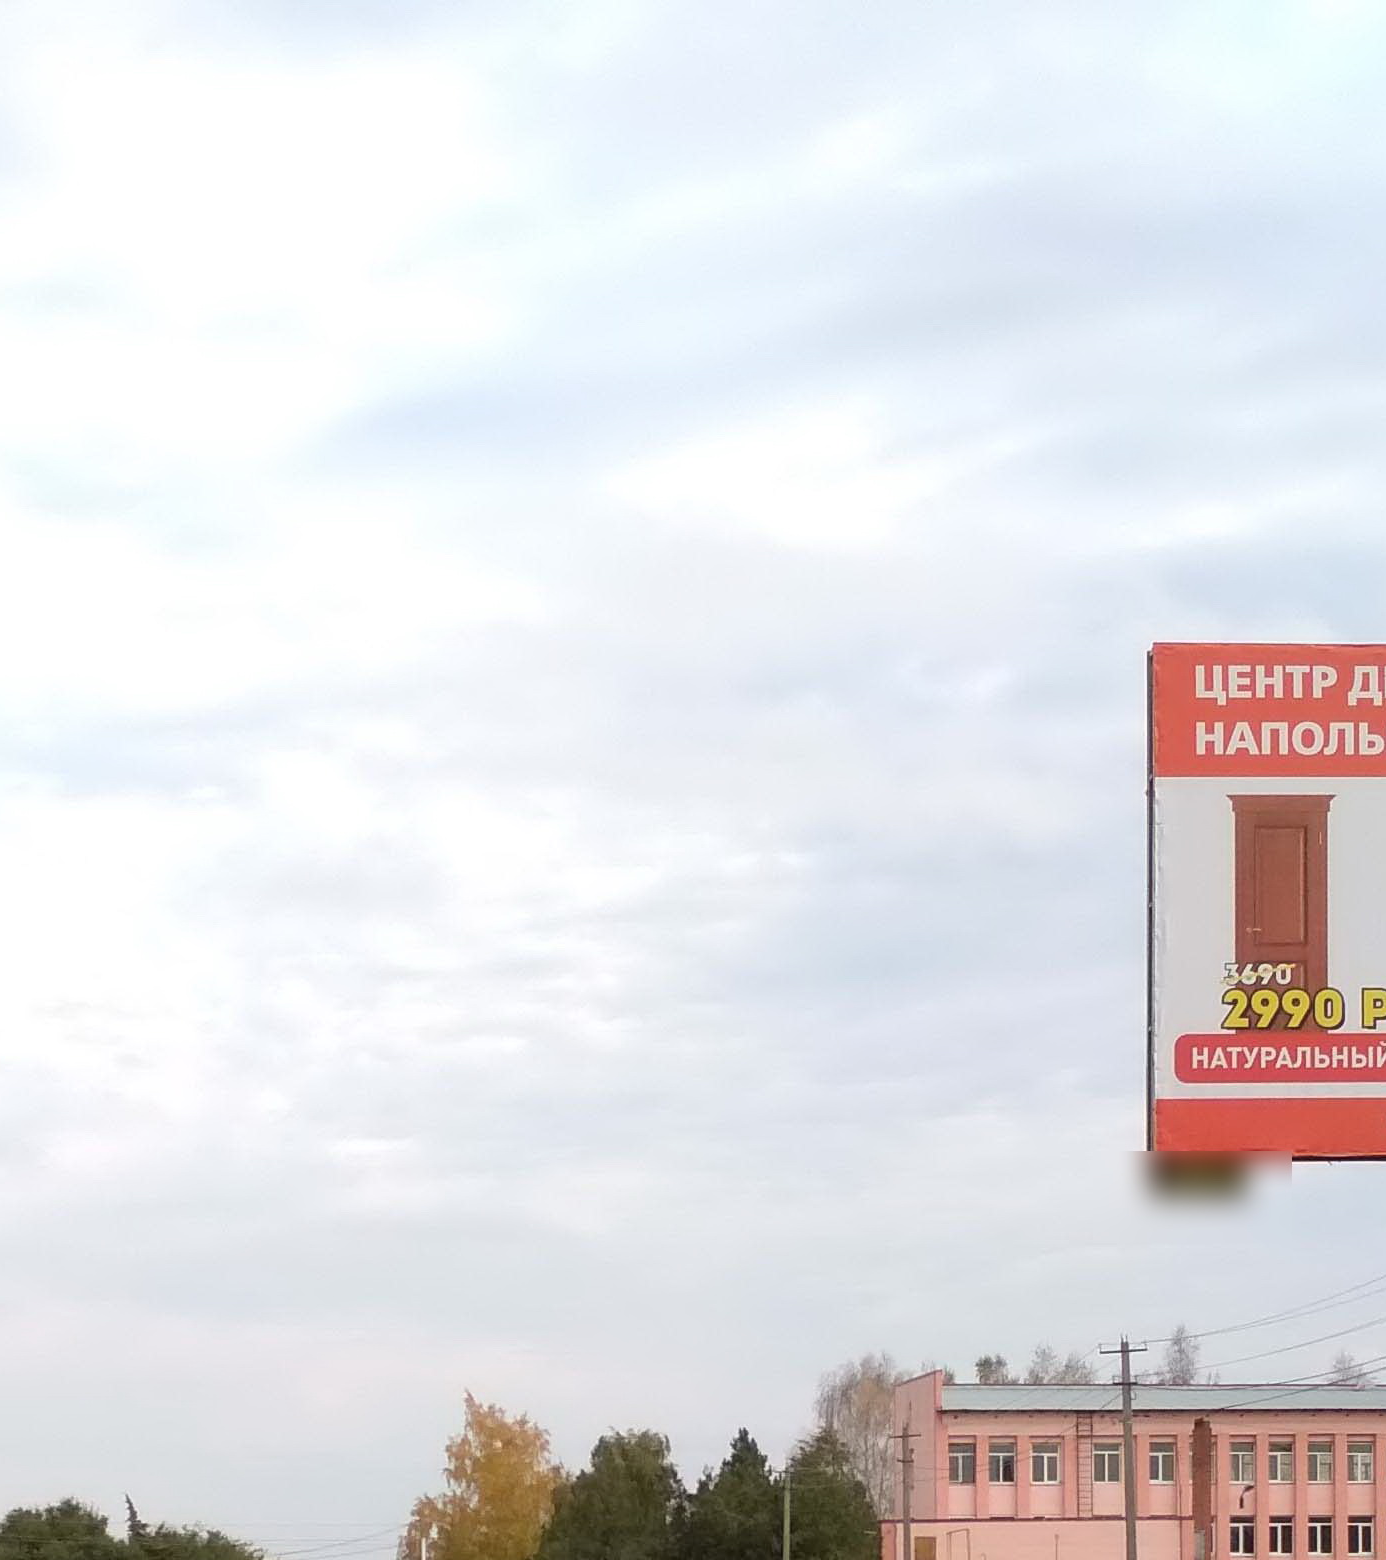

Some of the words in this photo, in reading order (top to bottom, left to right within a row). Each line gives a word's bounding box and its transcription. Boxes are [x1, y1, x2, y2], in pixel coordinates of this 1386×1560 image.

[1195, 664, 1337, 706] ЦЕНТР
[1222, 961, 1292, 986] 3690
[1221, 987, 1346, 1030] 2990
